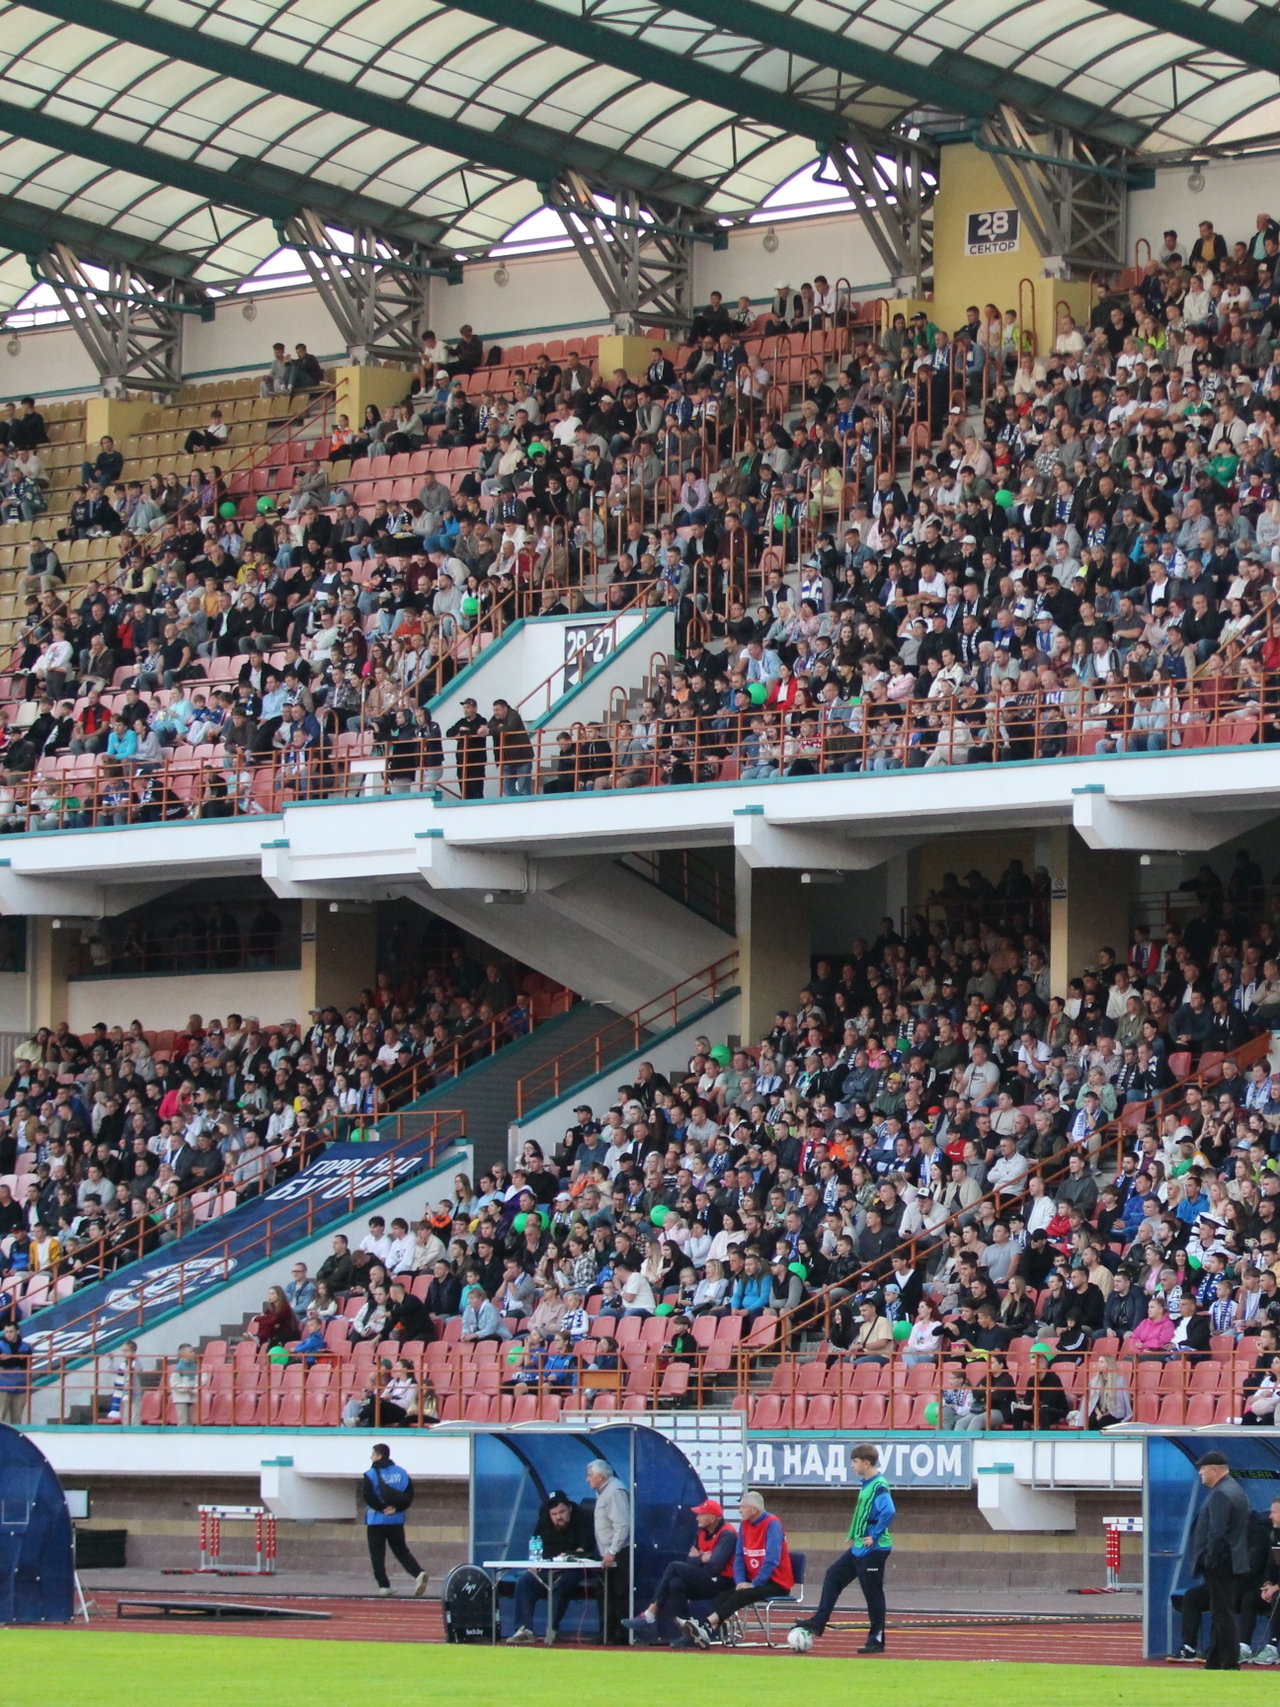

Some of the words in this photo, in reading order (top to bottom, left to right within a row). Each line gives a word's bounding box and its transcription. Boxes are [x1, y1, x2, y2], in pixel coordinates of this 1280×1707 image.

[977, 211, 1009, 236] 28
[969, 241, 1016, 255] СЕКТОР
[783, 1443, 847, 1482] НАД
[876, 1443, 962, 1478] УГОМ
